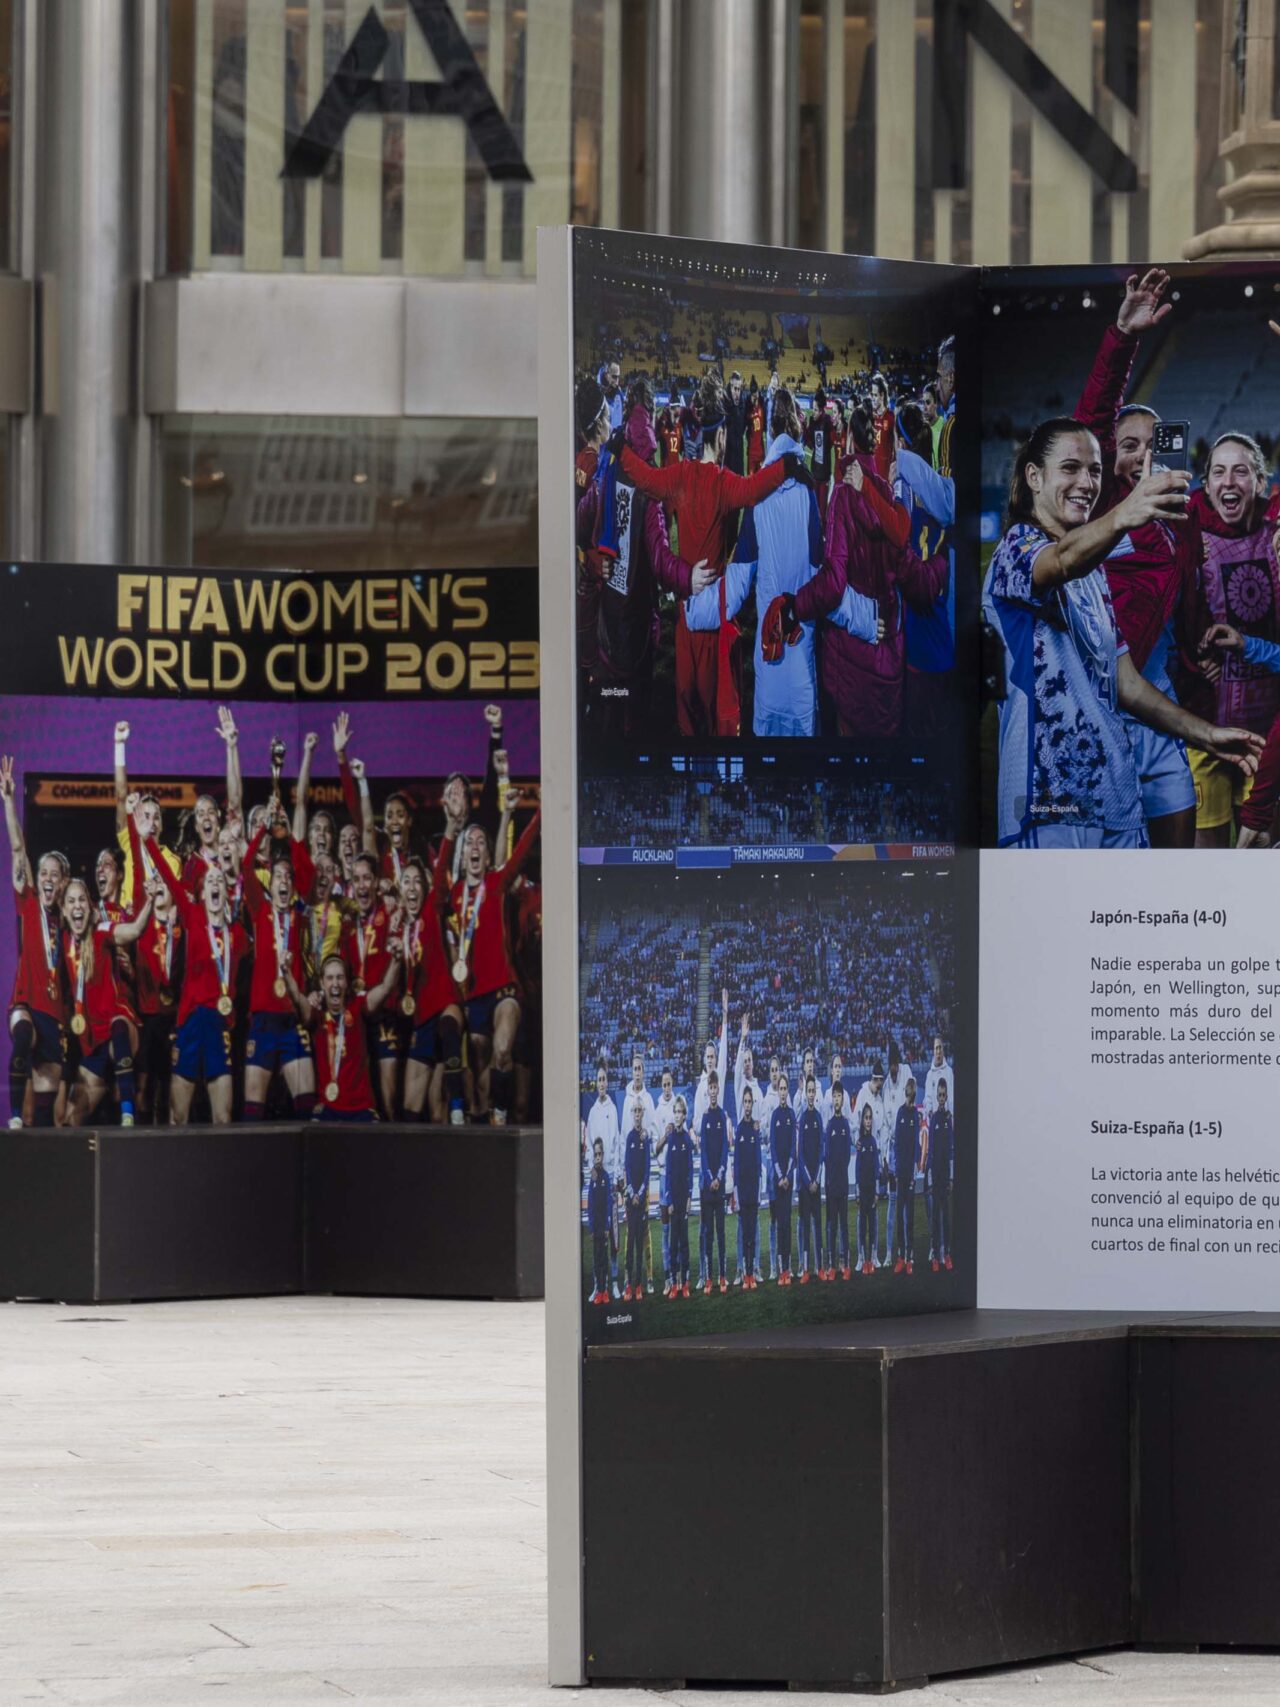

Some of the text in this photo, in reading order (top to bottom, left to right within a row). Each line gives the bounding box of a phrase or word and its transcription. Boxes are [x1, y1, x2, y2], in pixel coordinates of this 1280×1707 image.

[117, 573, 489, 634] FIFA WOMEN'S
[58, 635, 540, 691] WORLD CUP 2023
[632, 849, 674, 862] AUCKLAND
[912, 845, 927, 858] FIFA
[1089, 908, 1227, 928] Japón-España (4-0)
[1090, 955, 1132, 971] Nadie
[1136, 956, 1202, 975] esperaba
[1207, 960, 1226, 972] un
[1230, 956, 1271, 975] golpe
[1089, 979, 1136, 998] Japón,
[1143, 983, 1161, 995] en
[1168, 979, 1250, 998] Wellington,
[1090, 1004, 1160, 1018] momento
[1169, 1002, 1199, 1018] más
[1207, 1003, 1242, 1019] duro
[1250, 1003, 1273, 1019] del
[1090, 1026, 1166, 1044] imparable.
[1170, 1027, 1186, 1042] La
[1189, 1026, 1256, 1042] Selección
[1259, 1030, 1276, 1042] se
[1090, 1049, 1165, 1065] mostradas
[1168, 1050, 1272, 1066] anteriormente
[1090, 1119, 1223, 1139] Suiza-España (1-5)
[1091, 1166, 1107, 1181] La
[1109, 1166, 1163, 1182] victoria
[1166, 1168, 1198, 1182] ante
[1201, 1167, 1221, 1183] las
[1090, 1190, 1163, 1205] convenció
[1167, 1190, 1180, 1205] al
[1184, 1191, 1234, 1209] equipo
[1238, 1191, 1257, 1207] de
[1091, 1216, 1134, 1228] nunca
[1137, 1217, 1164, 1229] una
[1167, 1213, 1253, 1230] eliminatoria
[1256, 1218, 1274, 1230] en
[1090, 1238, 1144, 1252] cuartos
[1147, 1236, 1166, 1252] de
[1168, 1236, 1200, 1253] final
[1204, 1241, 1230, 1253] con
[1234, 1241, 1252, 1253] un
